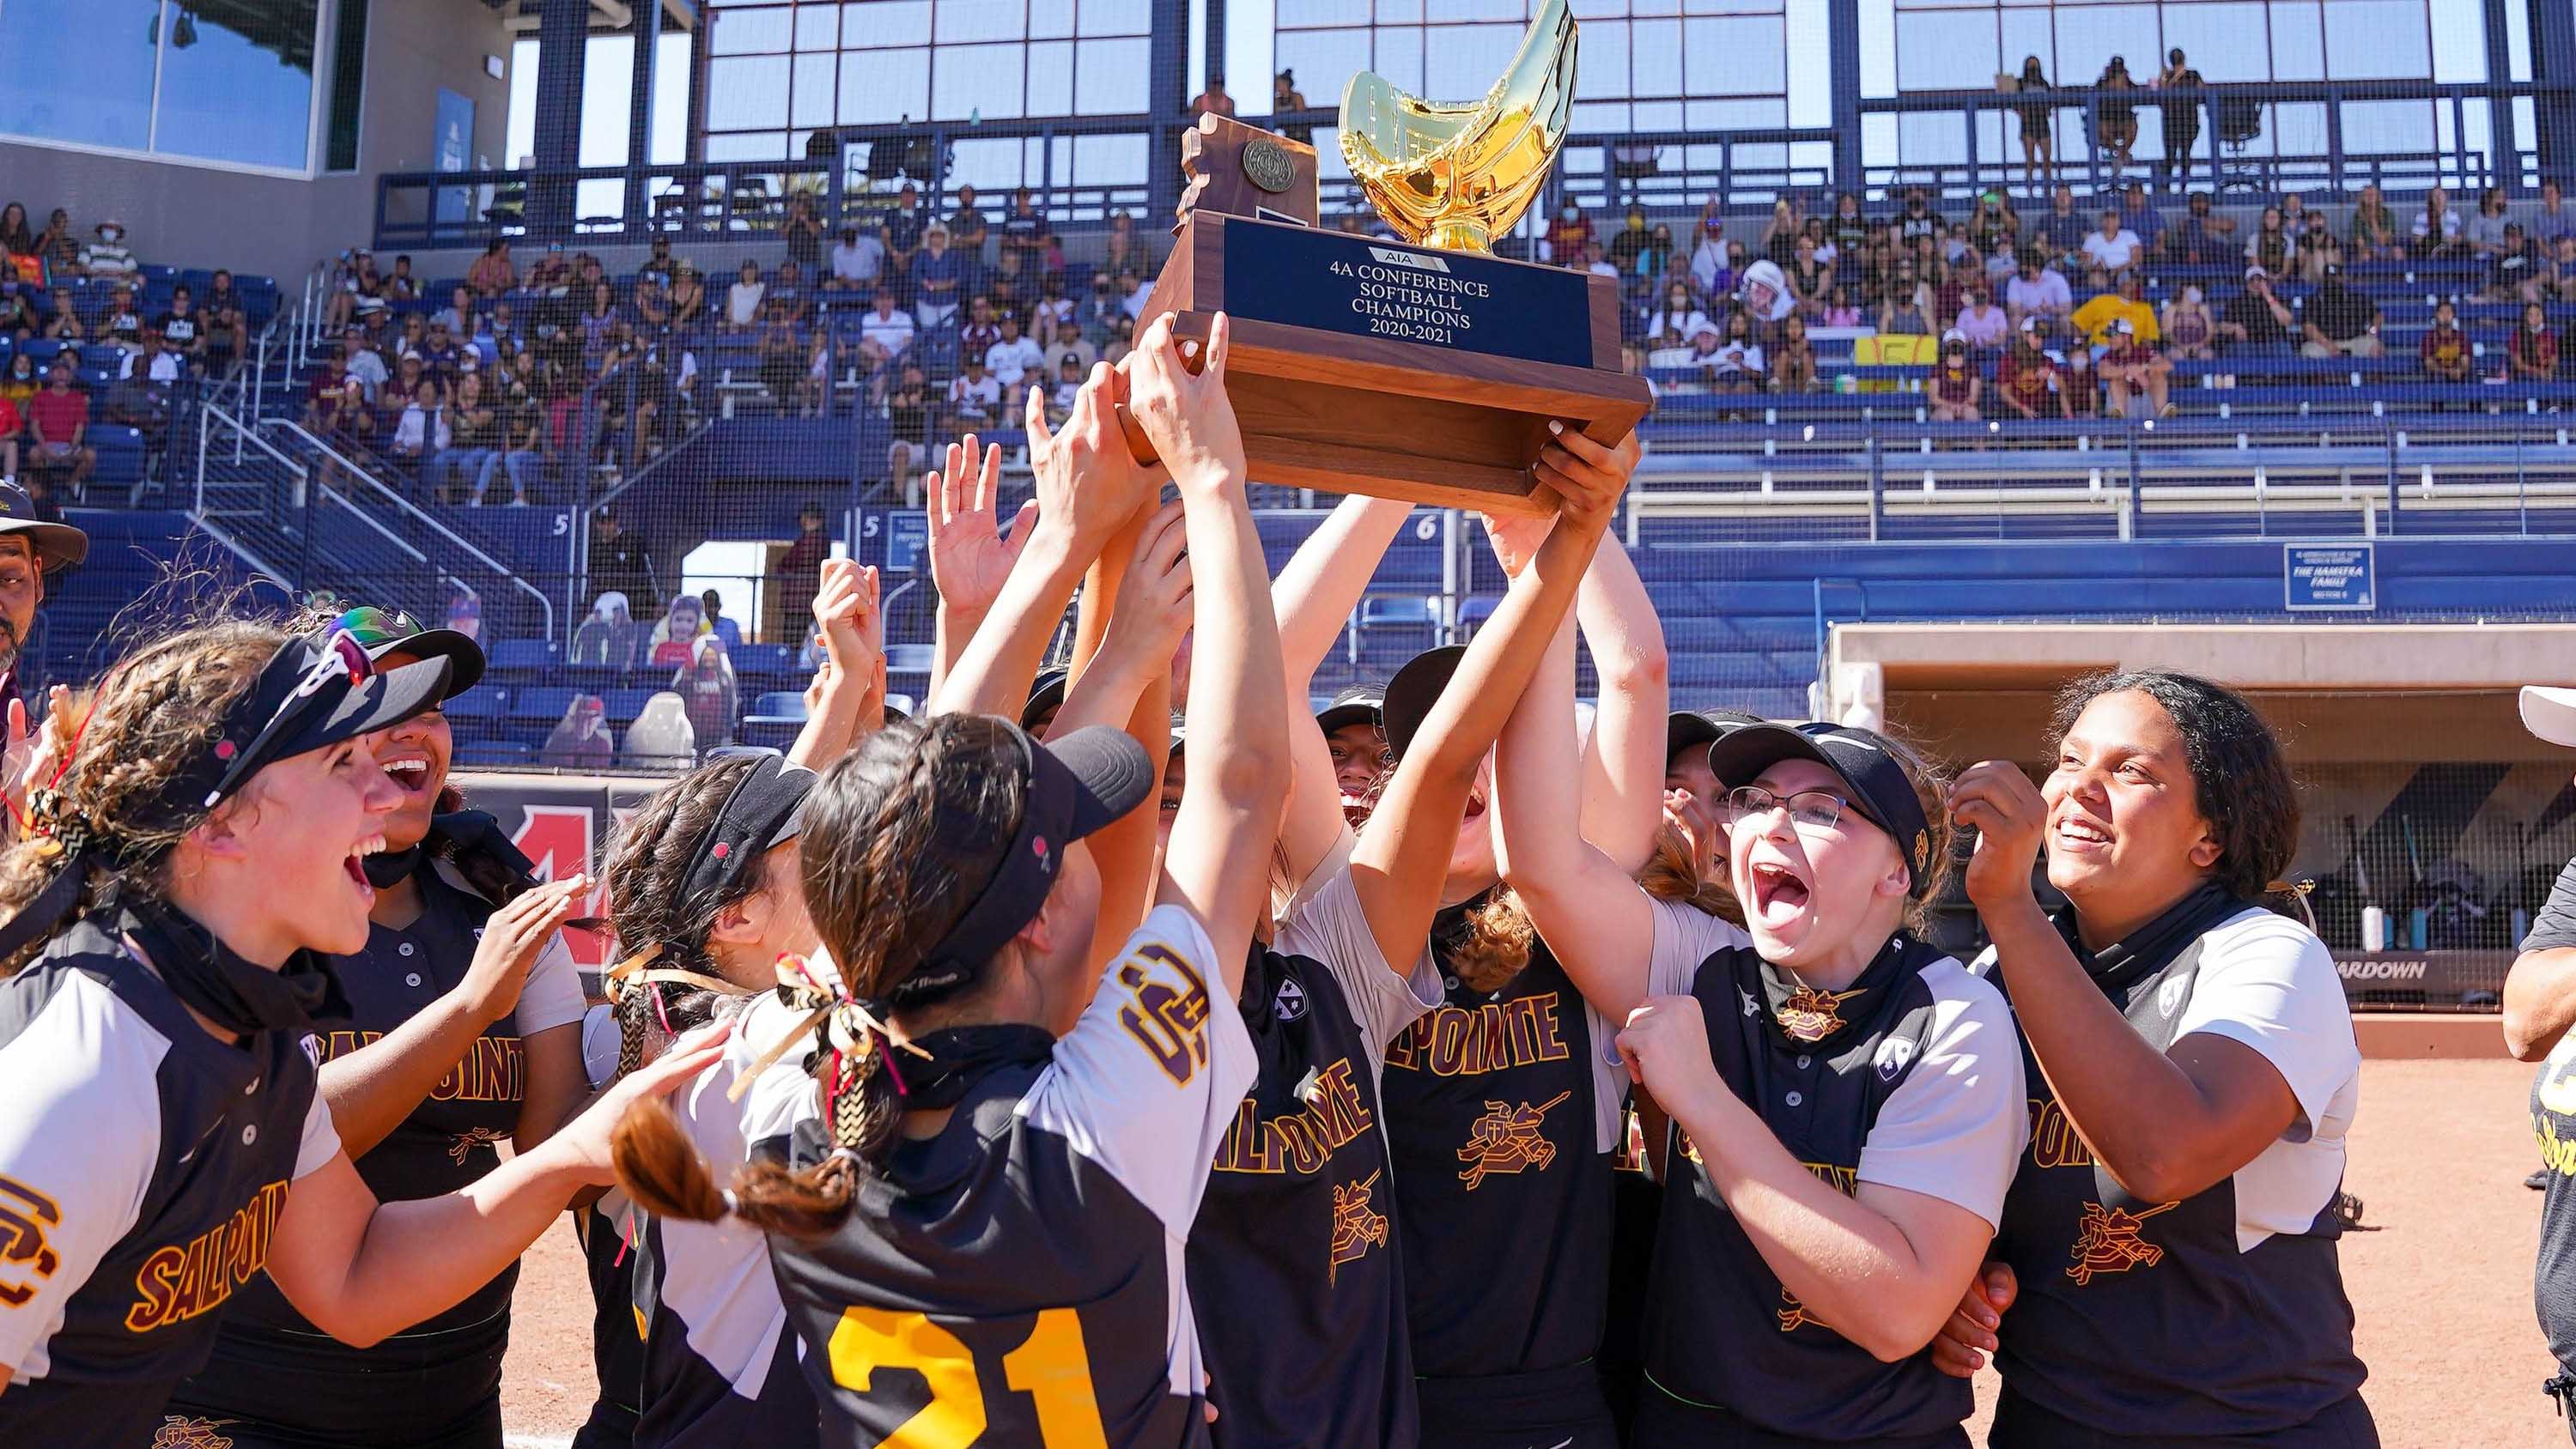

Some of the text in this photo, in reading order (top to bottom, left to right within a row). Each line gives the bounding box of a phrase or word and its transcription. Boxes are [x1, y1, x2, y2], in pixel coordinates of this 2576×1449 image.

[1384, 252, 1413, 265] AIA
[1330, 260, 1490, 298] 4A CONFERENCE
[1360, 282, 1462, 311] SOFTBALL
[1352, 298, 1471, 329] CHAMPIONS
[1370, 318, 1453, 343] 2020-2021
[553, 514, 569, 535] 5
[863, 515, 880, 537] 5
[1416, 514, 1437, 540] 6
[2293, 567, 2315, 578] THE
[2310, 577, 2348, 588] FAMILY
[2335, 961, 2427, 979] ARDOWN
[827, 1305, 1109, 1449] 21
